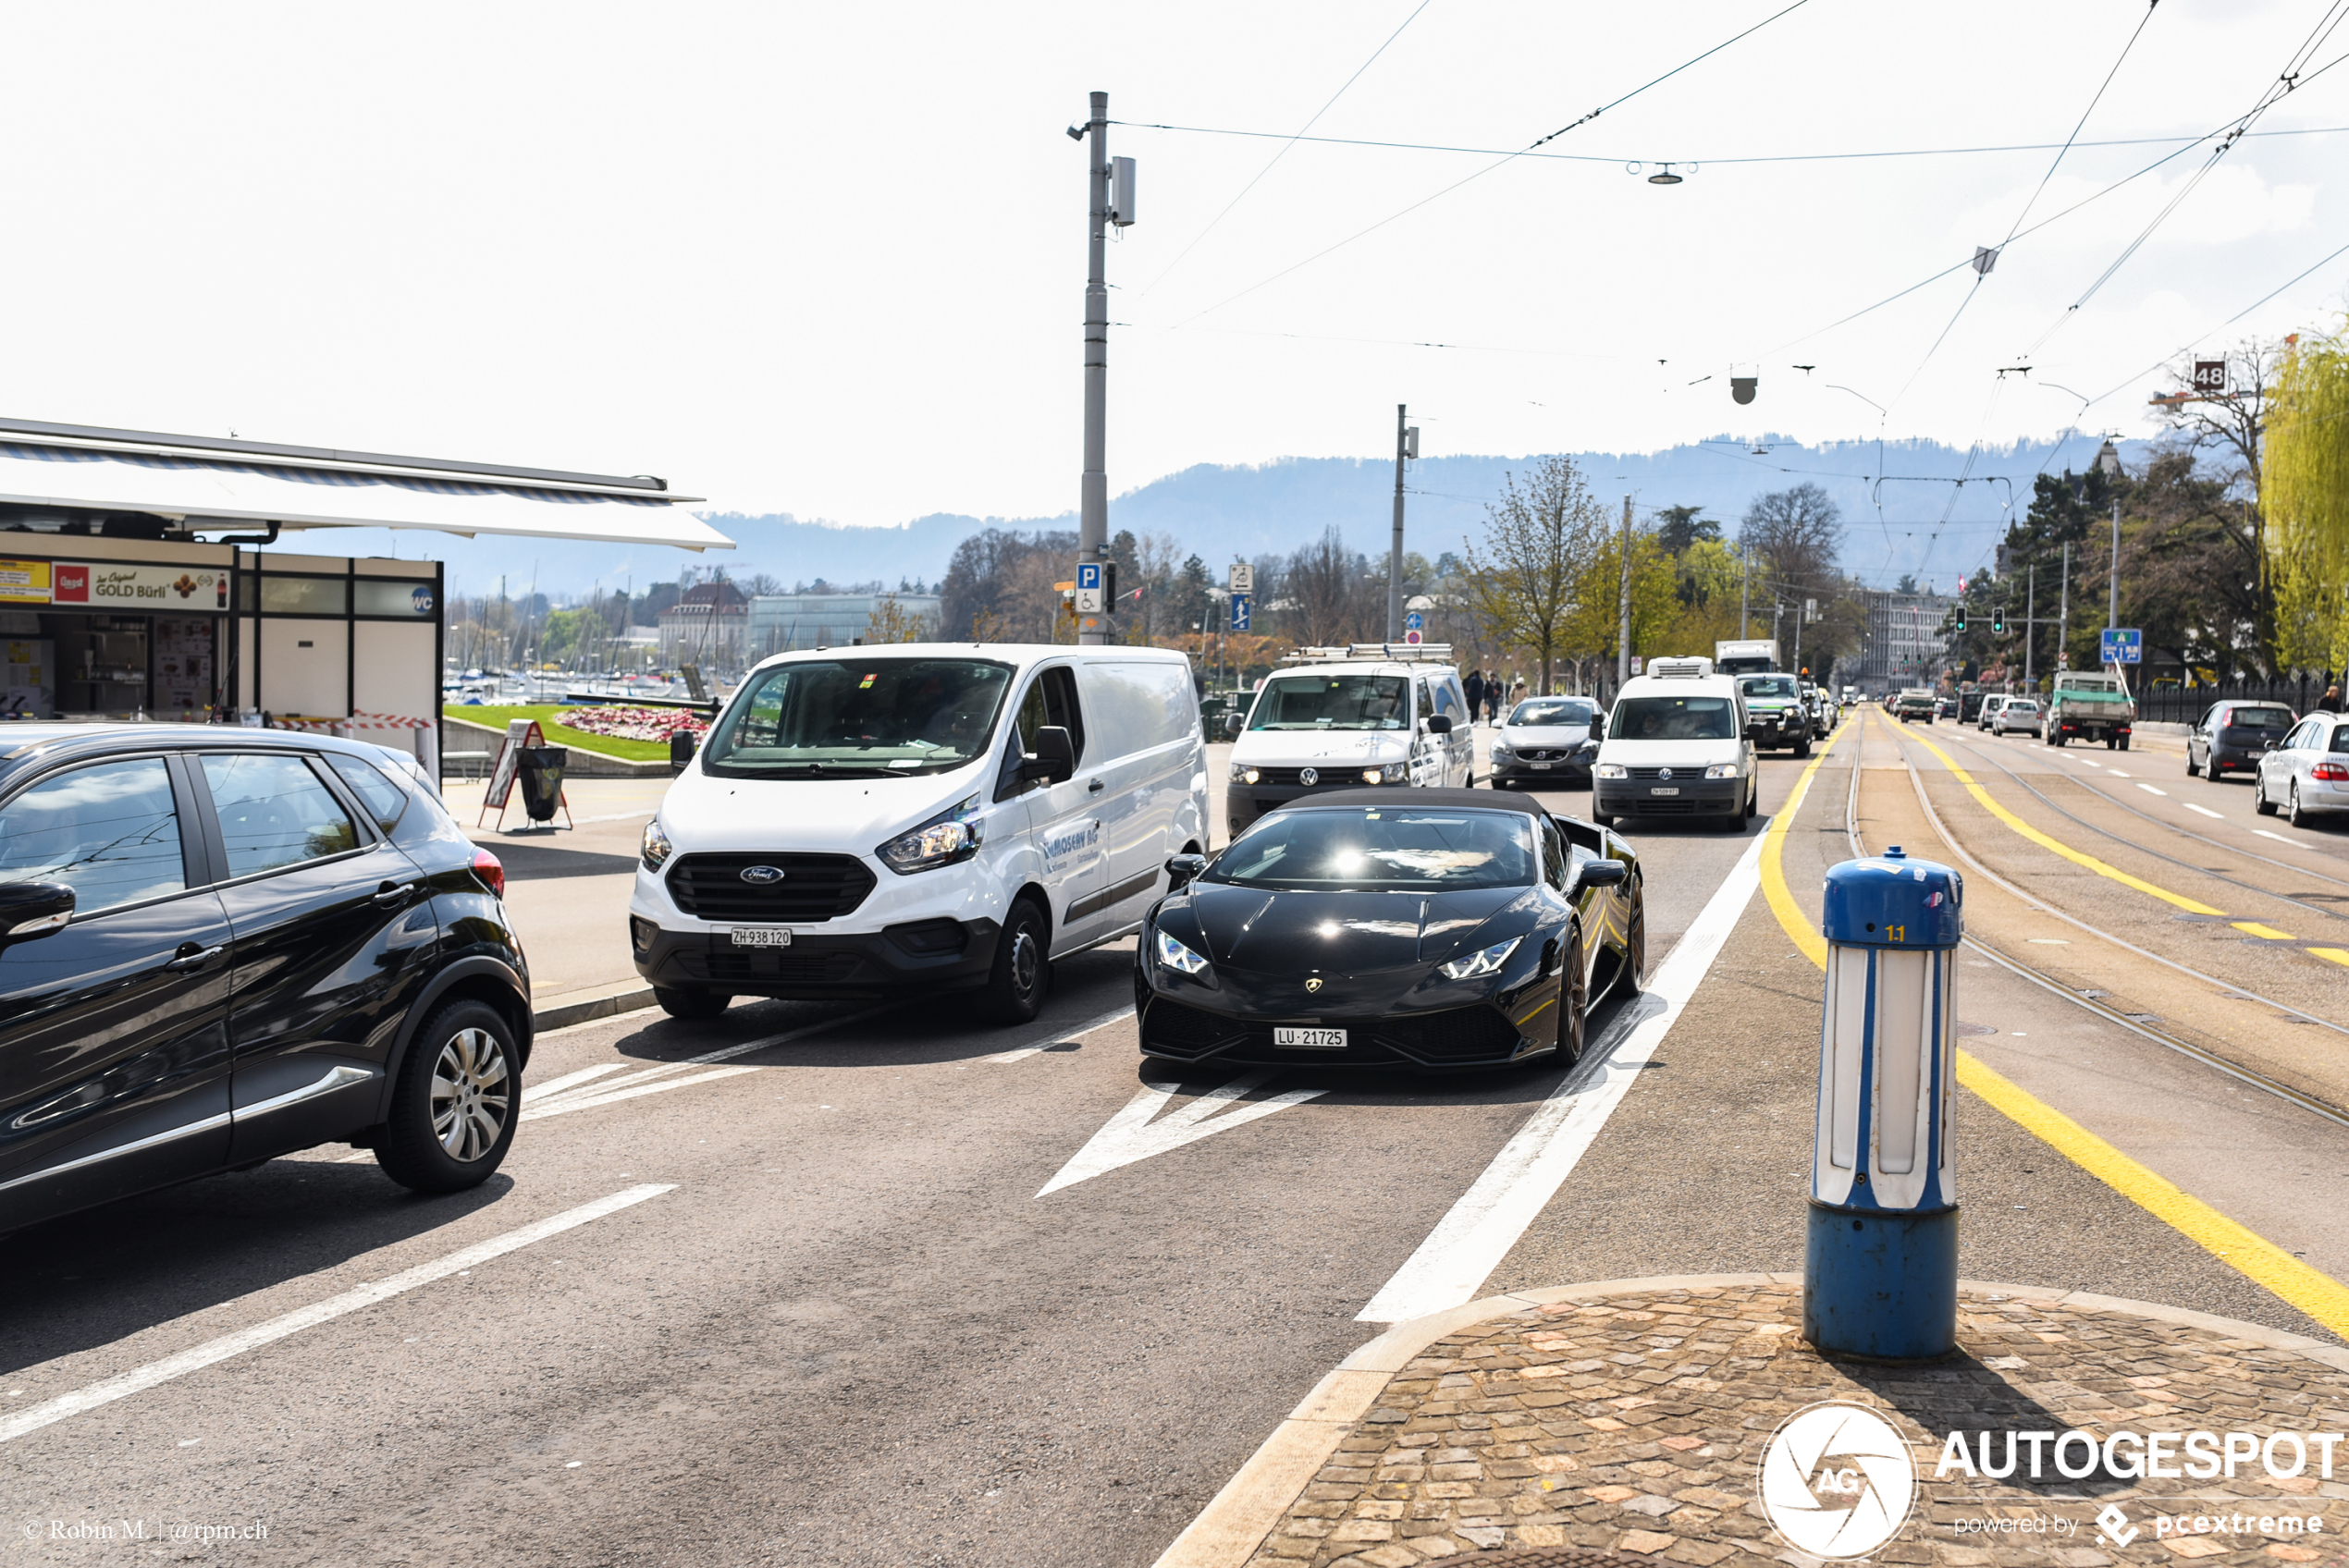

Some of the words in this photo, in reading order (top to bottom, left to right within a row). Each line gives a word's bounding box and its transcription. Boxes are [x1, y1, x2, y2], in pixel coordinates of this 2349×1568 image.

[2195, 367, 2224, 385] 48
[1083, 568, 1096, 587] P
[95, 583, 134, 597] GOLD
[411, 596, 433, 610] WC
[1087, 827, 1098, 845] AG
[748, 868, 773, 879] Ford
[770, 931, 790, 944] 120
